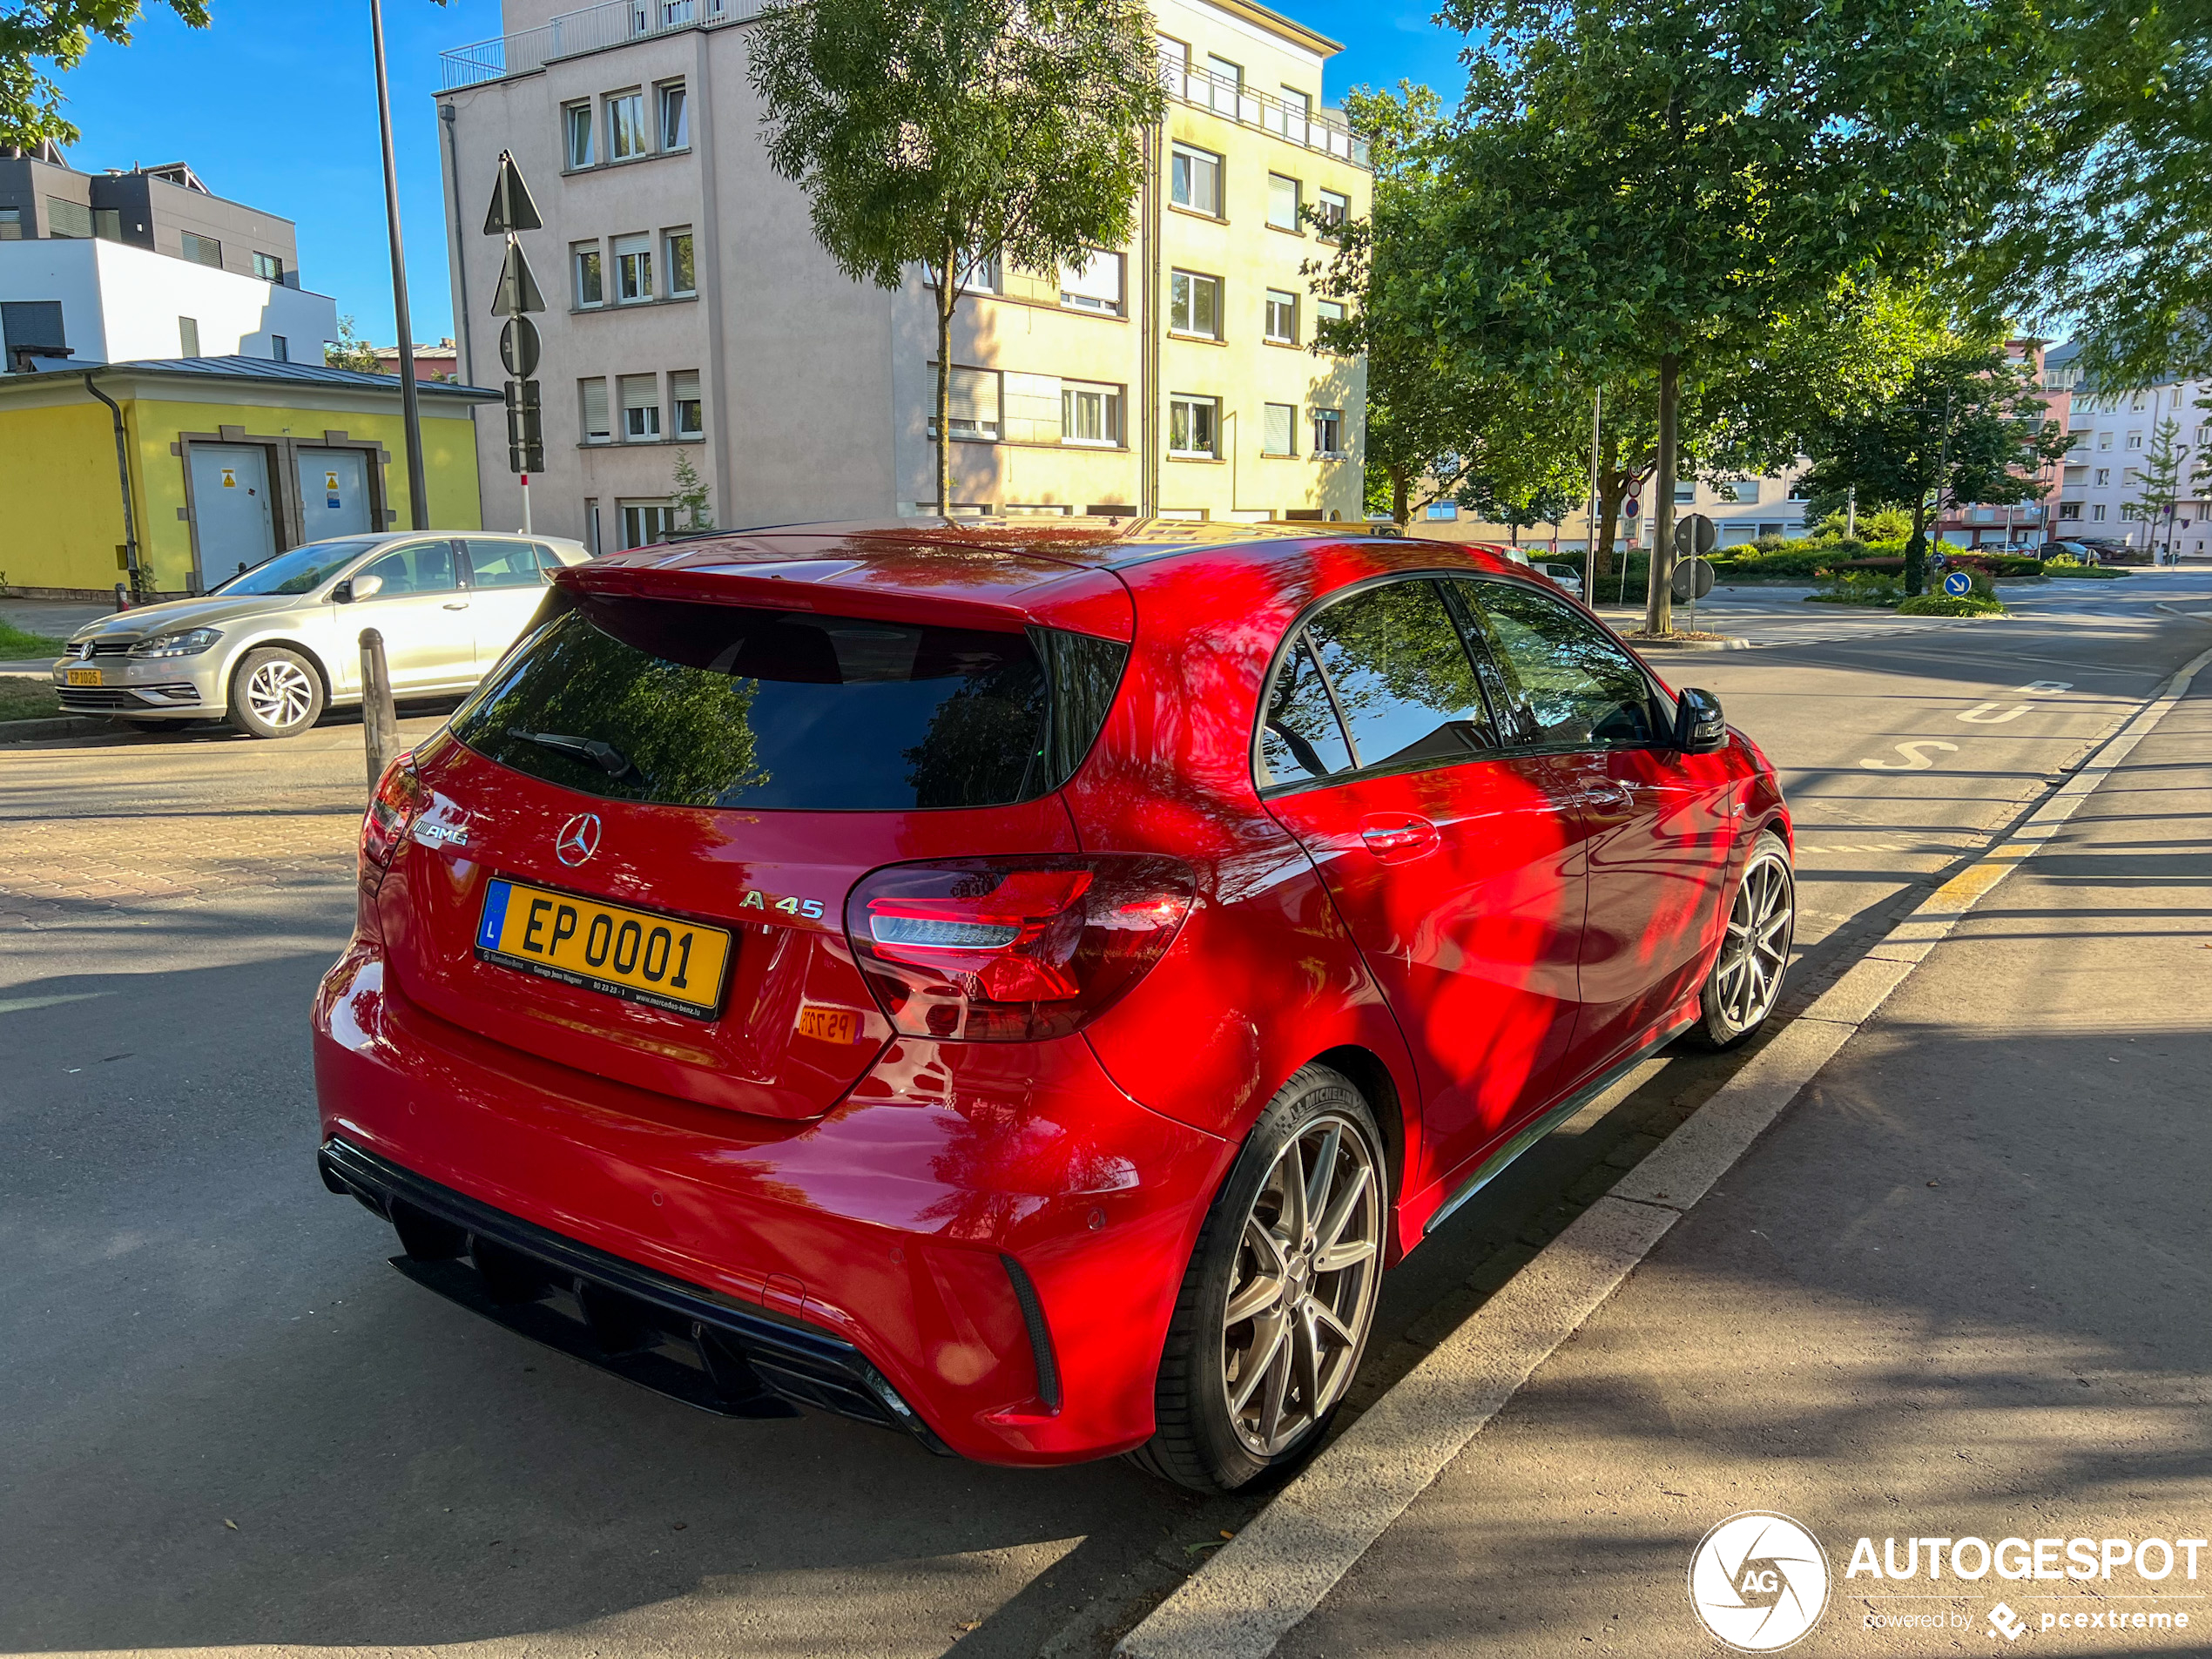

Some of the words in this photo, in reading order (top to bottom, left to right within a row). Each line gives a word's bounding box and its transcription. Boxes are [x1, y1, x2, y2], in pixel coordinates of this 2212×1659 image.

[80, 671, 98, 684] 1025
[425, 825, 469, 846] AMG
[739, 890, 764, 910] A
[775, 896, 825, 919] 45
[487, 921, 495, 939] L
[523, 899, 578, 955] EP
[585, 914, 693, 988] 0001
[534, 965, 551, 976] Garage
[563, 973, 583, 984] Wagner
[602, 983, 609, 992] 23
[636, 994, 701, 1016] www.mercedes-benz.lu
[1305, 1087, 1353, 1109] MICHELIN
